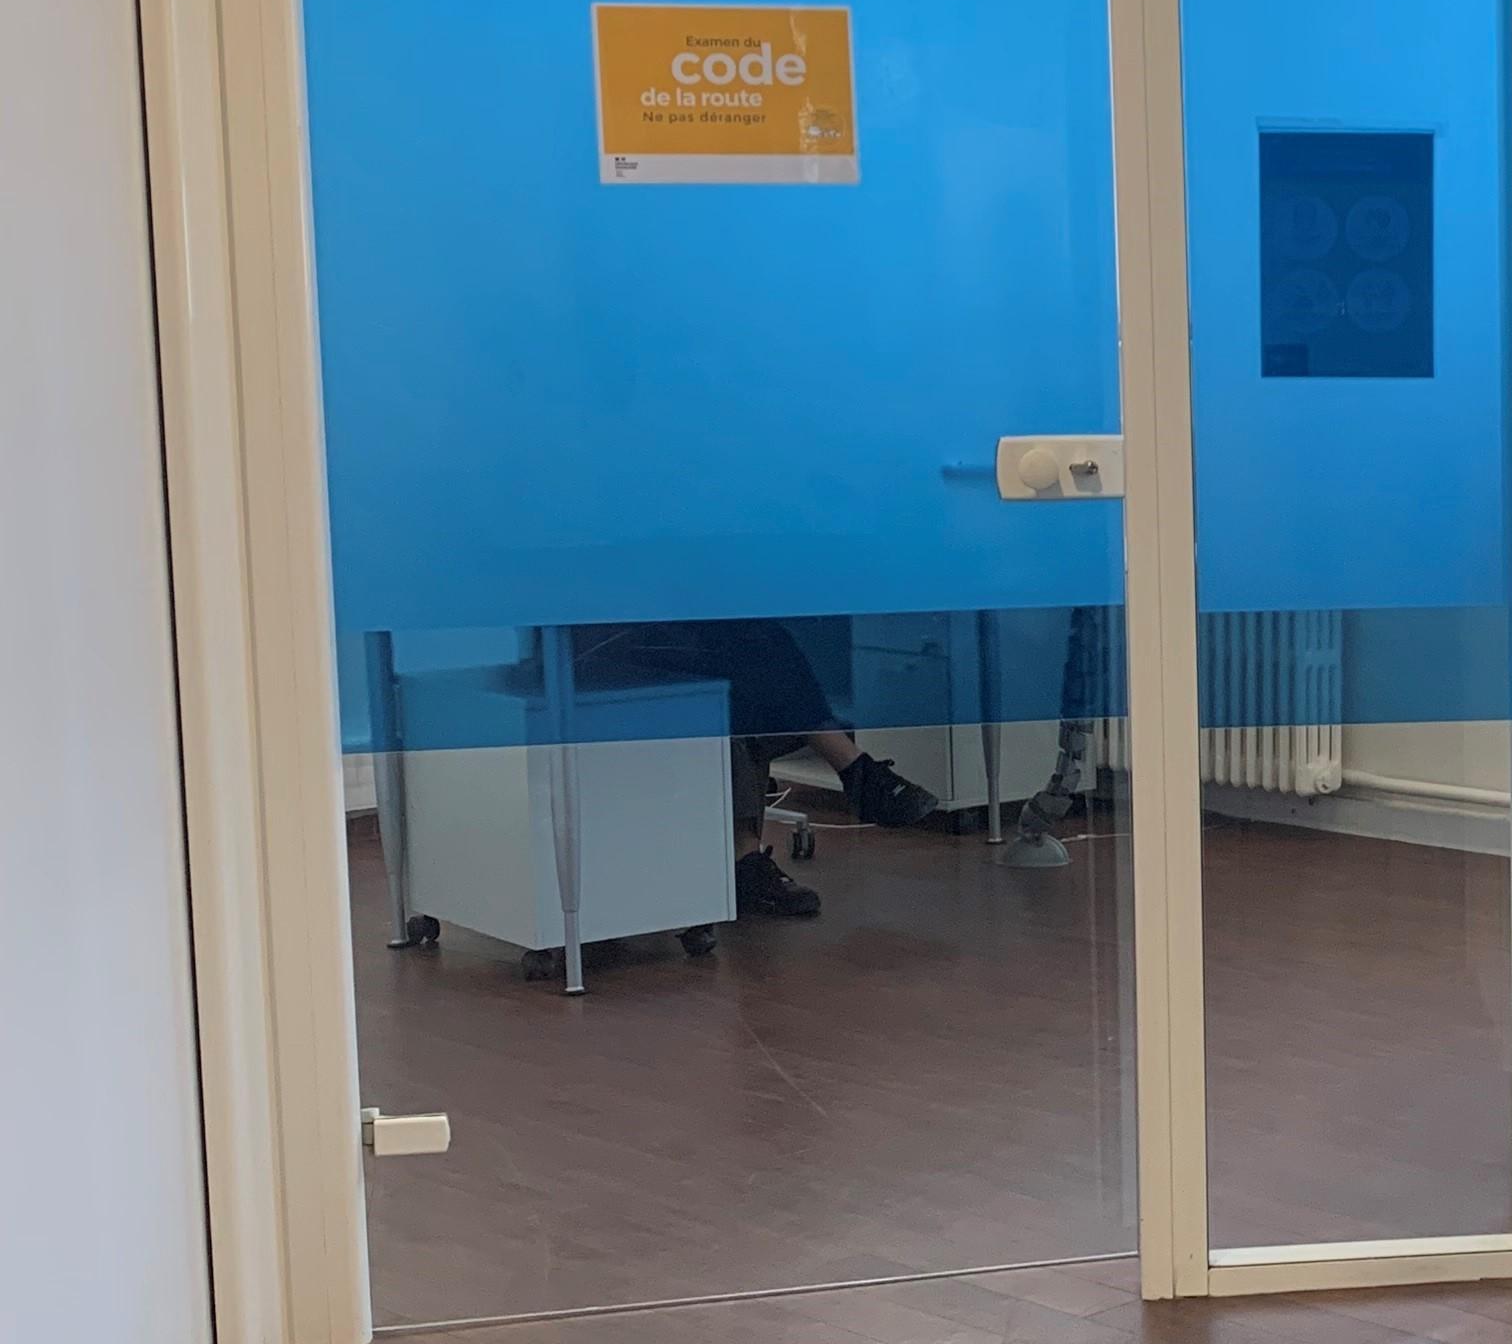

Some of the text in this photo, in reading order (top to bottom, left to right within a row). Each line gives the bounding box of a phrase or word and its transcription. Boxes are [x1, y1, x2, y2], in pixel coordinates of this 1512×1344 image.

[686, 35, 762, 48] Examen du
[671, 42, 807, 86] code
[640, 87, 763, 108] de la route
[643, 110, 766, 127] Ne pas déranger
